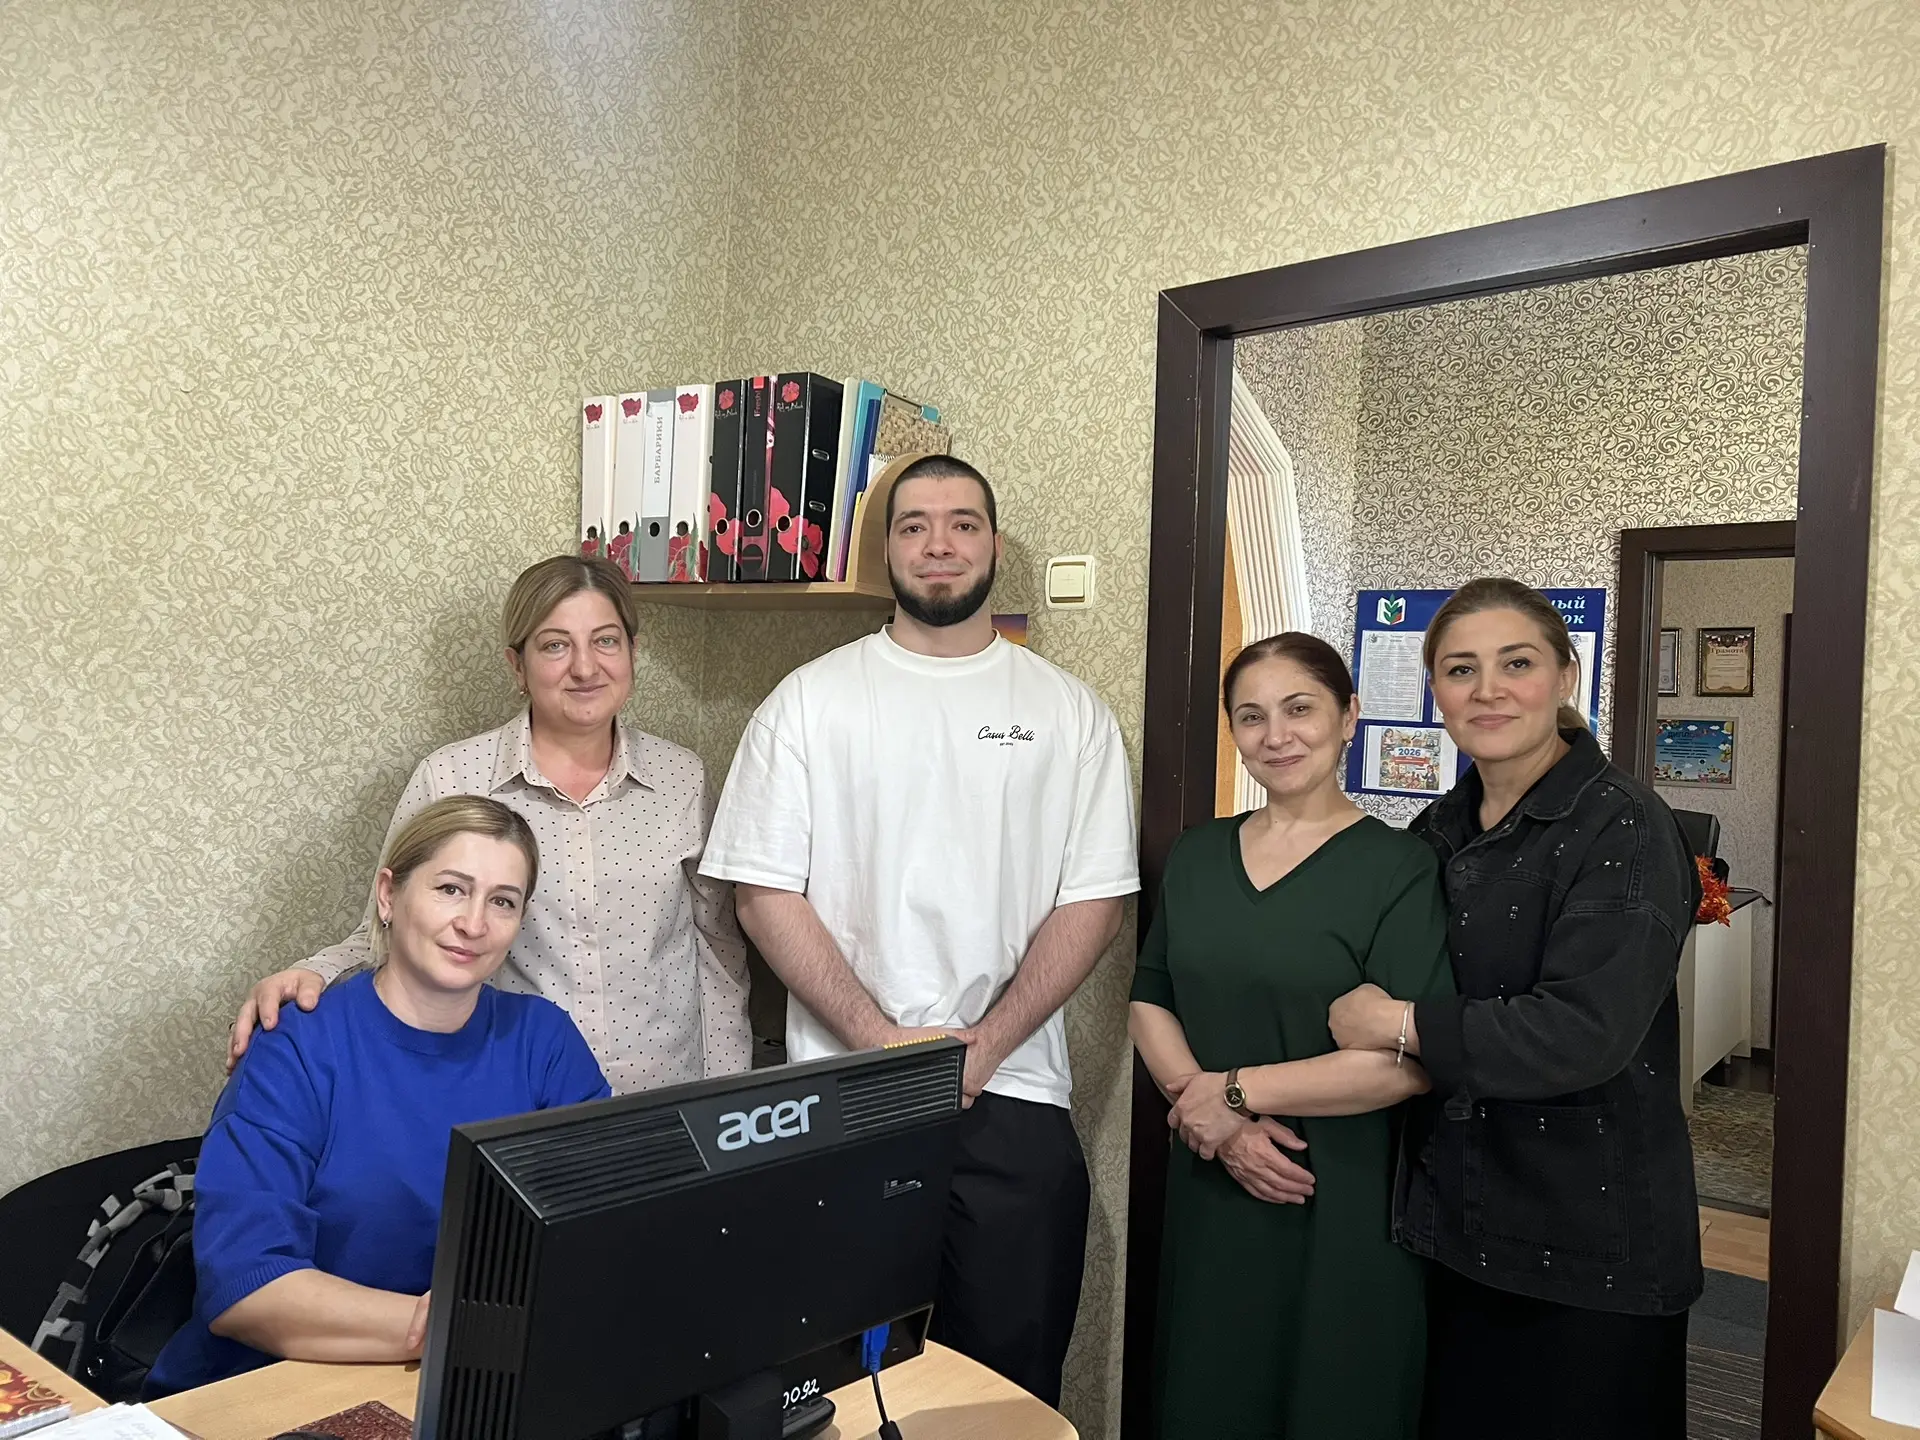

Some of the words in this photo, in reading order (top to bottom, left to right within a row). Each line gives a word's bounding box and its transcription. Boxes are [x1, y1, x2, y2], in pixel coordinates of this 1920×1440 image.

[653, 417, 663, 484] БАРБАРИКИ
[977, 725, 1005, 740] Casus
[1007, 725, 1035, 741] Belli
[1398, 748, 1421, 756] 2026
[717, 1094, 820, 1151] acer
